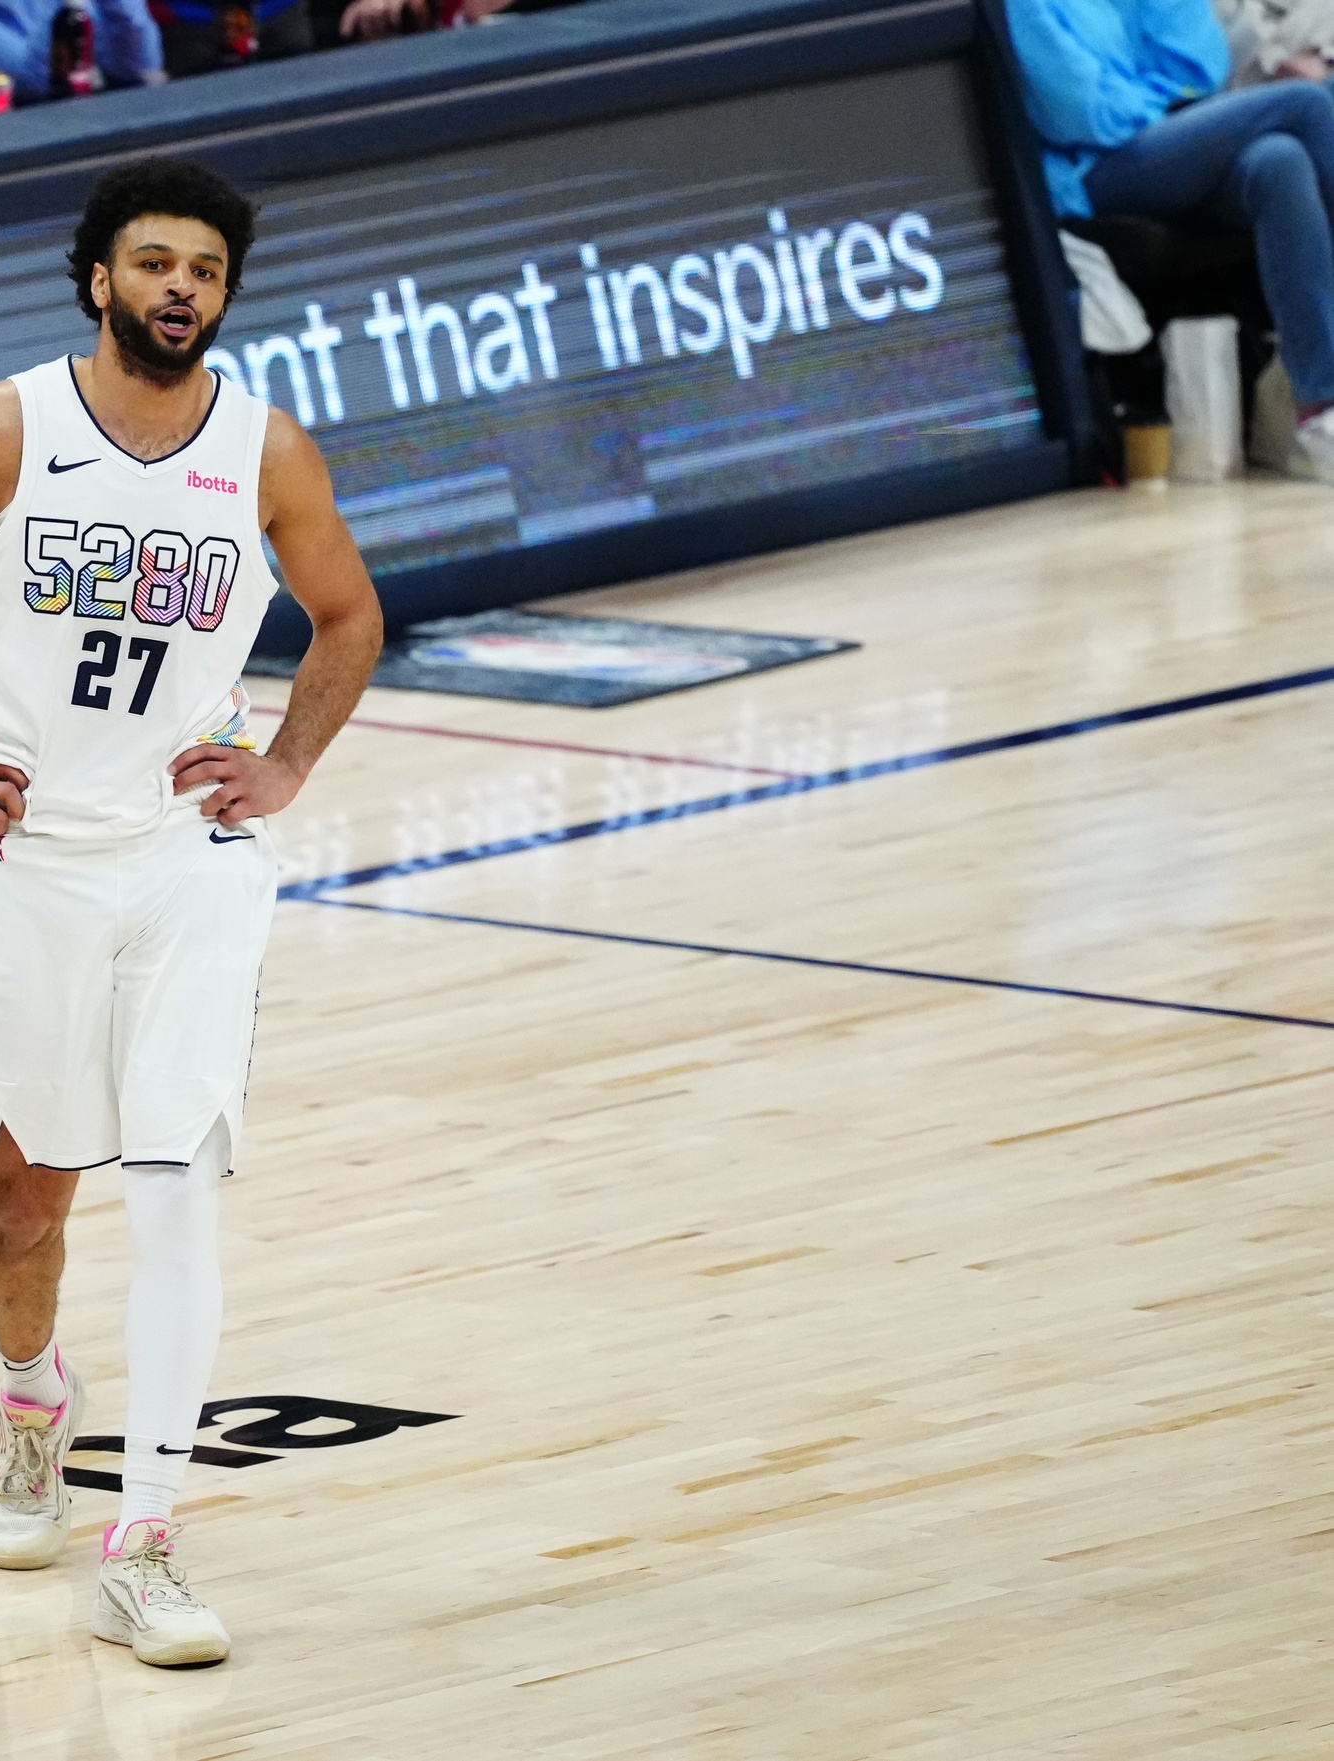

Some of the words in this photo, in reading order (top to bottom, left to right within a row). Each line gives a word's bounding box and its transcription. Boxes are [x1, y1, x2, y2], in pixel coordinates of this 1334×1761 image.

[364, 262, 559, 409] that
[580, 209, 945, 379] inspires
[187, 469, 238, 494] ibotta
[23, 517, 241, 632] 5280
[71, 631, 169, 716] 27
